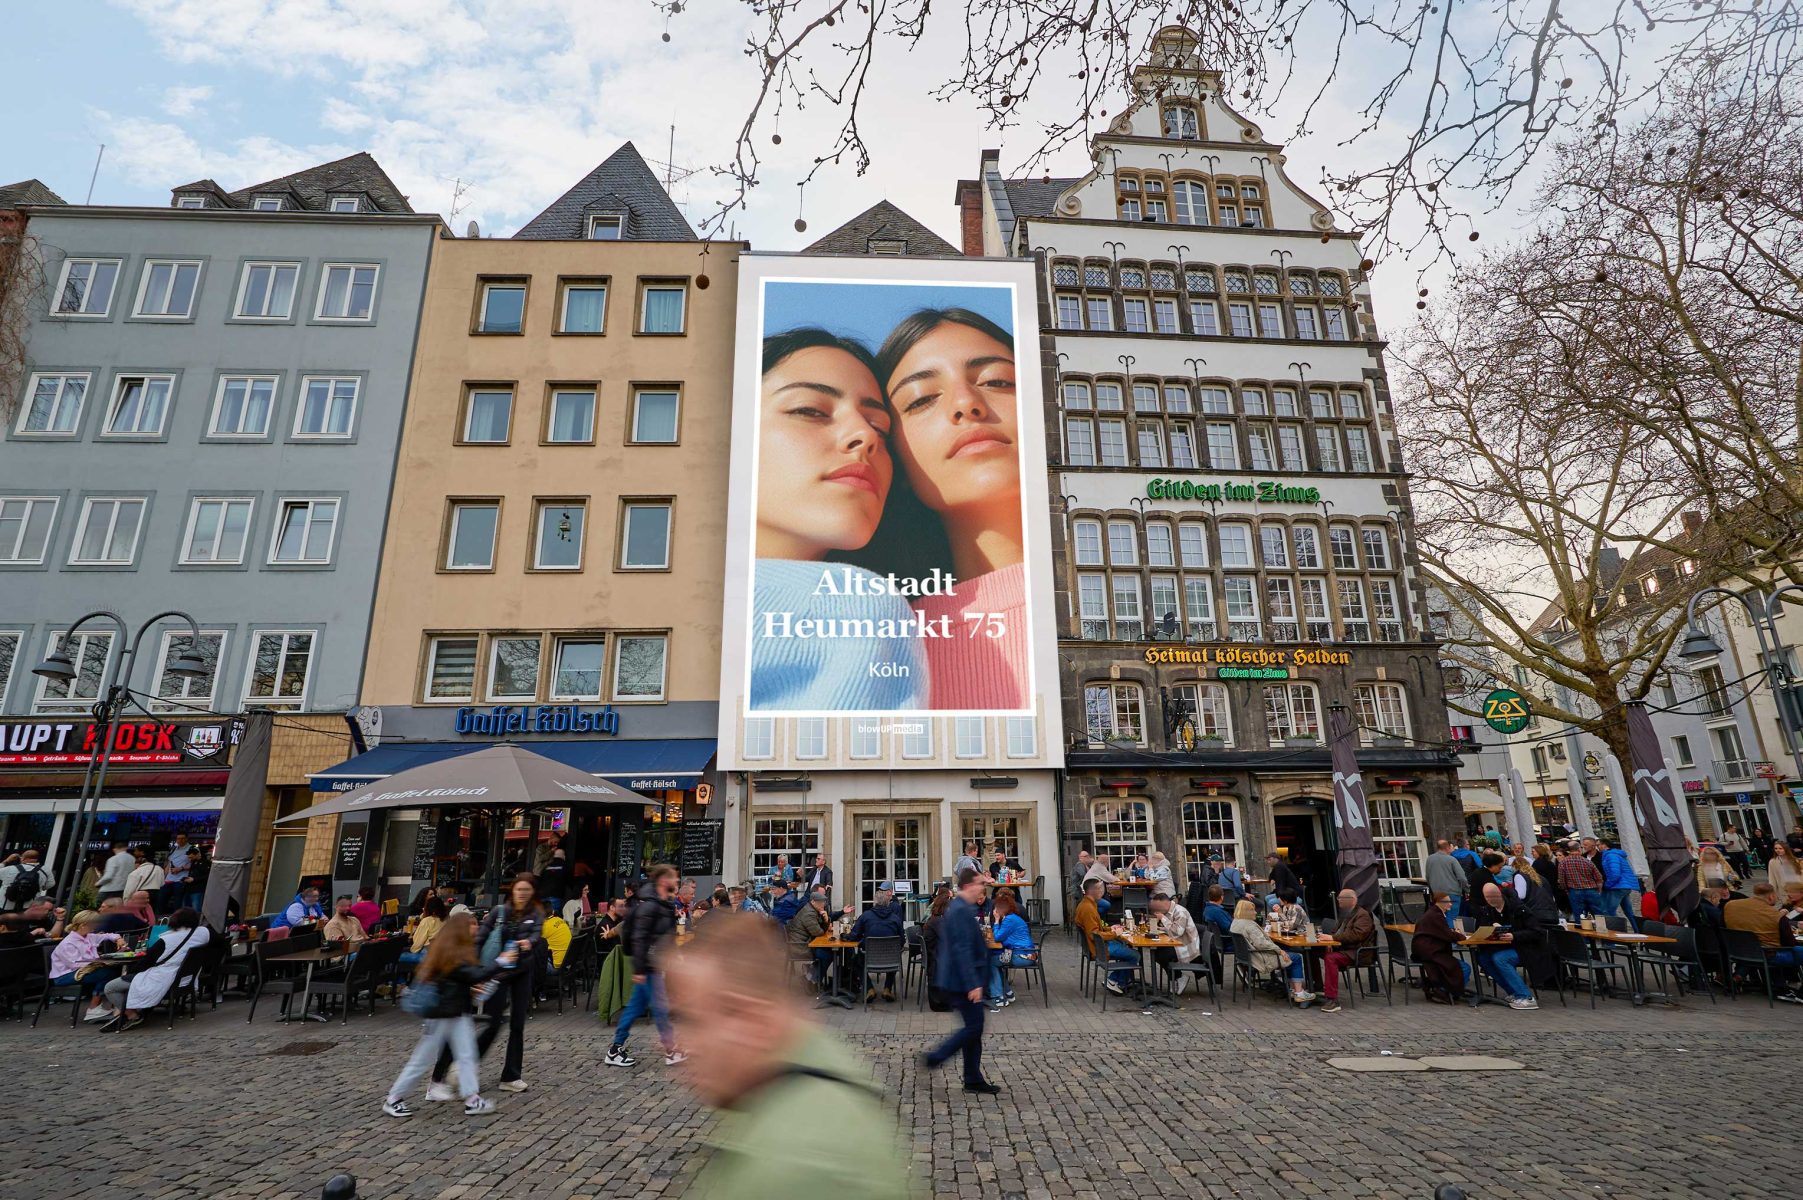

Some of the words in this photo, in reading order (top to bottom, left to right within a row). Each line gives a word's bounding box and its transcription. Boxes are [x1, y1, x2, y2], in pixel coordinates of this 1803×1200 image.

[1146, 478, 1222, 501] Gilden
[1224, 480, 1256, 501] im
[1257, 481, 1321, 503] Zims
[812, 568, 957, 597] Altstadt
[762, 610, 954, 639] Heumarkt
[963, 612, 1006, 639] 75
[1145, 647, 1209, 664] Heimat
[1215, 648, 1286, 665] kölscher
[1293, 649, 1350, 666] Helden
[868, 661, 910, 678] Köln
[1219, 667, 1249, 678] Gilden
[1250, 668, 1263, 678] im
[1263, 668, 1289, 679] Zims
[455, 705, 530, 736] Gaffel
[534, 704, 619, 736] Kölsch
[427, 786, 489, 796] Kölsch
